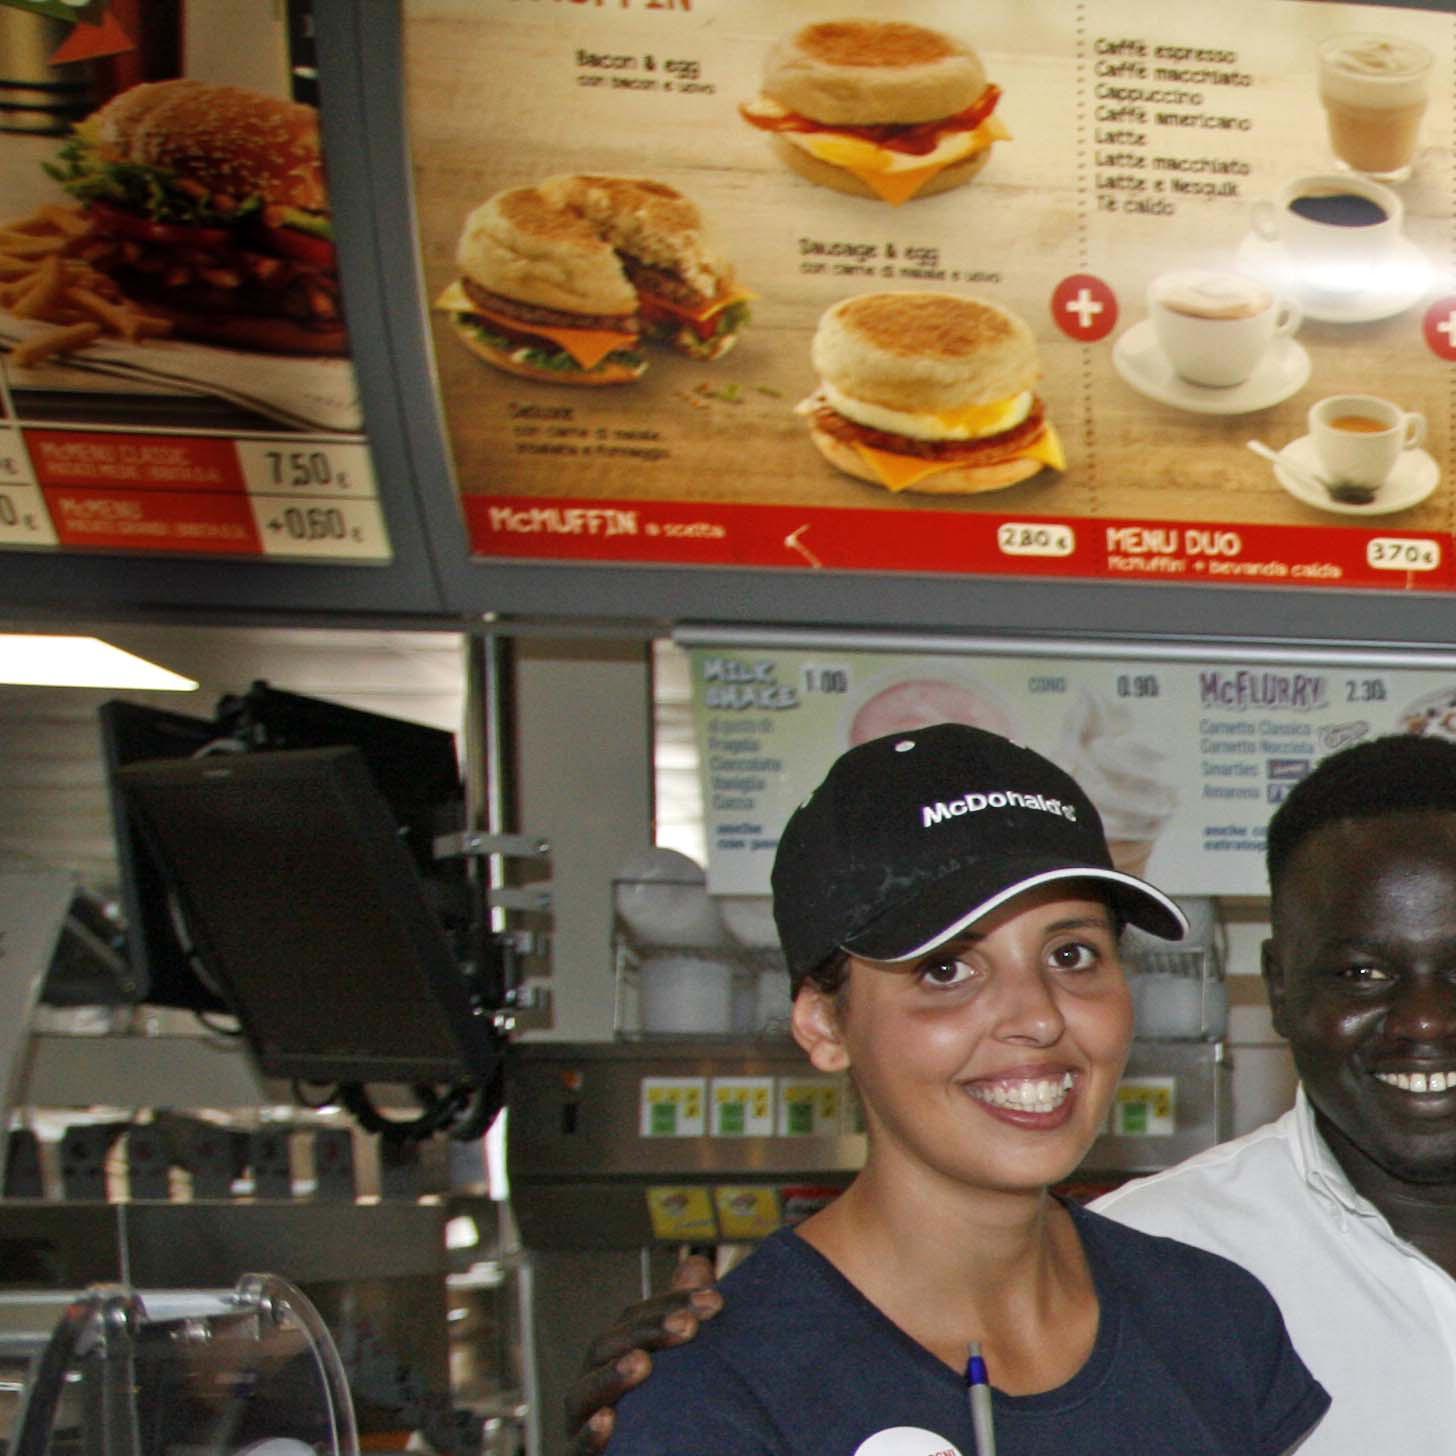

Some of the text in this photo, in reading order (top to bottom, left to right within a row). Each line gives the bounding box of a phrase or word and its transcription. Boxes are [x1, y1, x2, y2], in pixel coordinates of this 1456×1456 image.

[488, 505, 639, 537] McMUFFIN
[1106, 526, 1243, 558] MENU DUO
[1199, 670, 1328, 710] McFLURRY
[921, 789, 1077, 829] McDonald's
